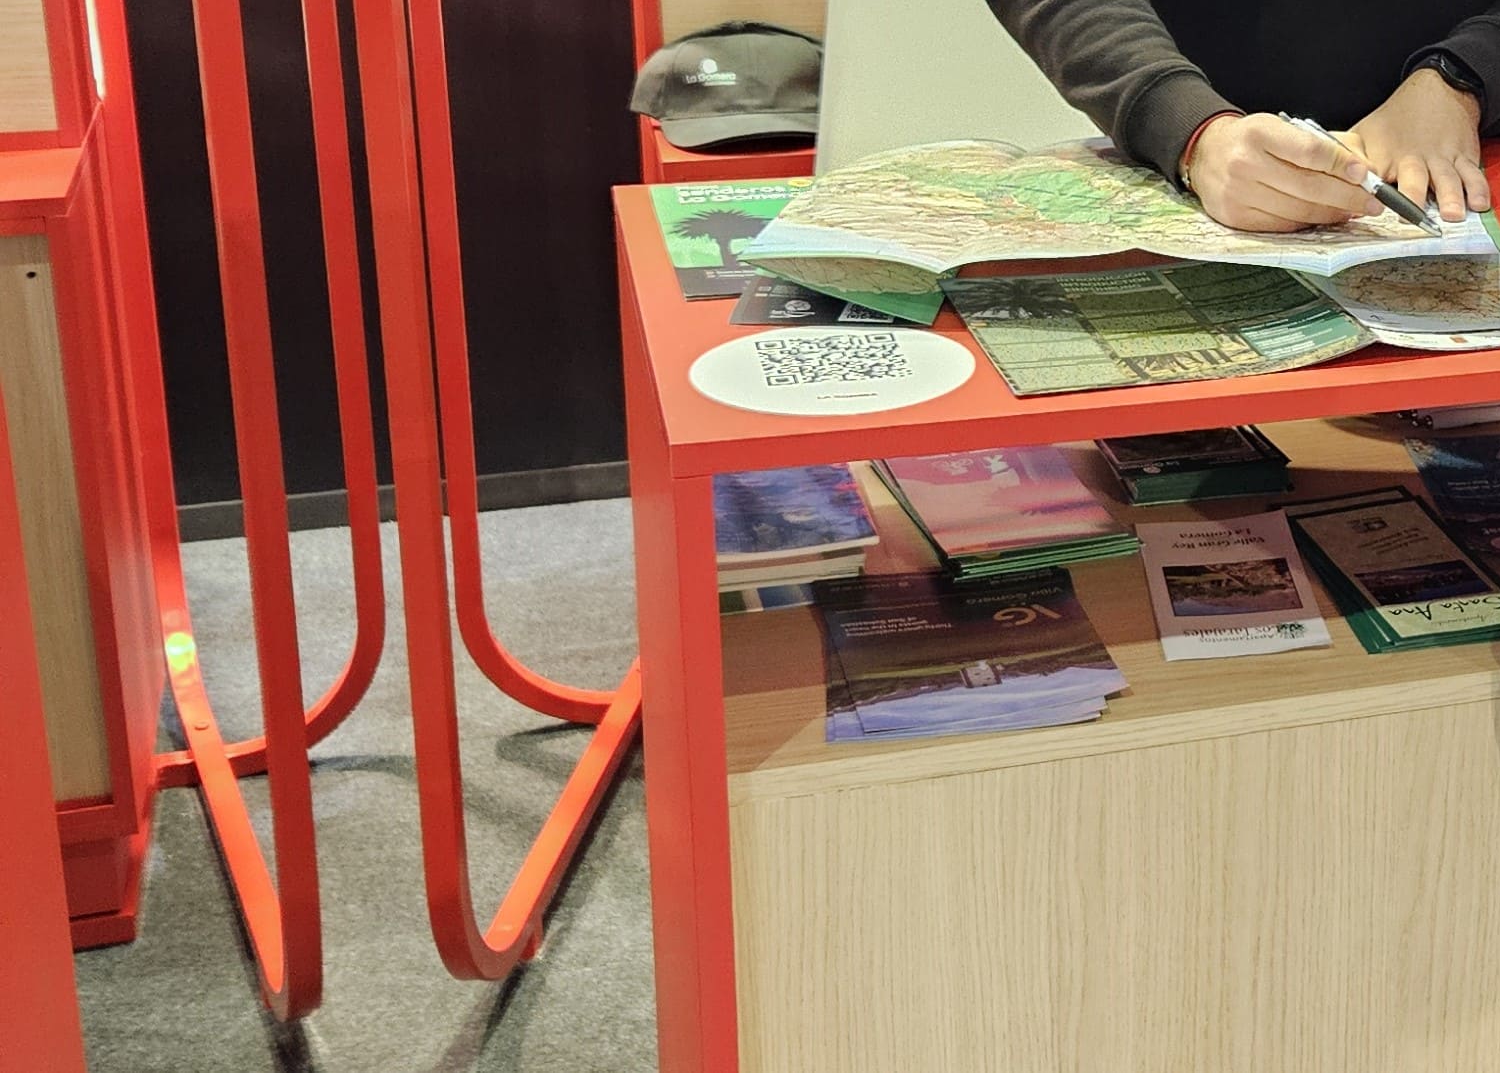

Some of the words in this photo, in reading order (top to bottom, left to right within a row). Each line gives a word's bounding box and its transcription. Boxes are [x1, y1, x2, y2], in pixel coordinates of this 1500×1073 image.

[1171, 542, 1196, 550] Rey
[1199, 539, 1231, 548] Gran
[1388, 601, 1442, 621] Ana
